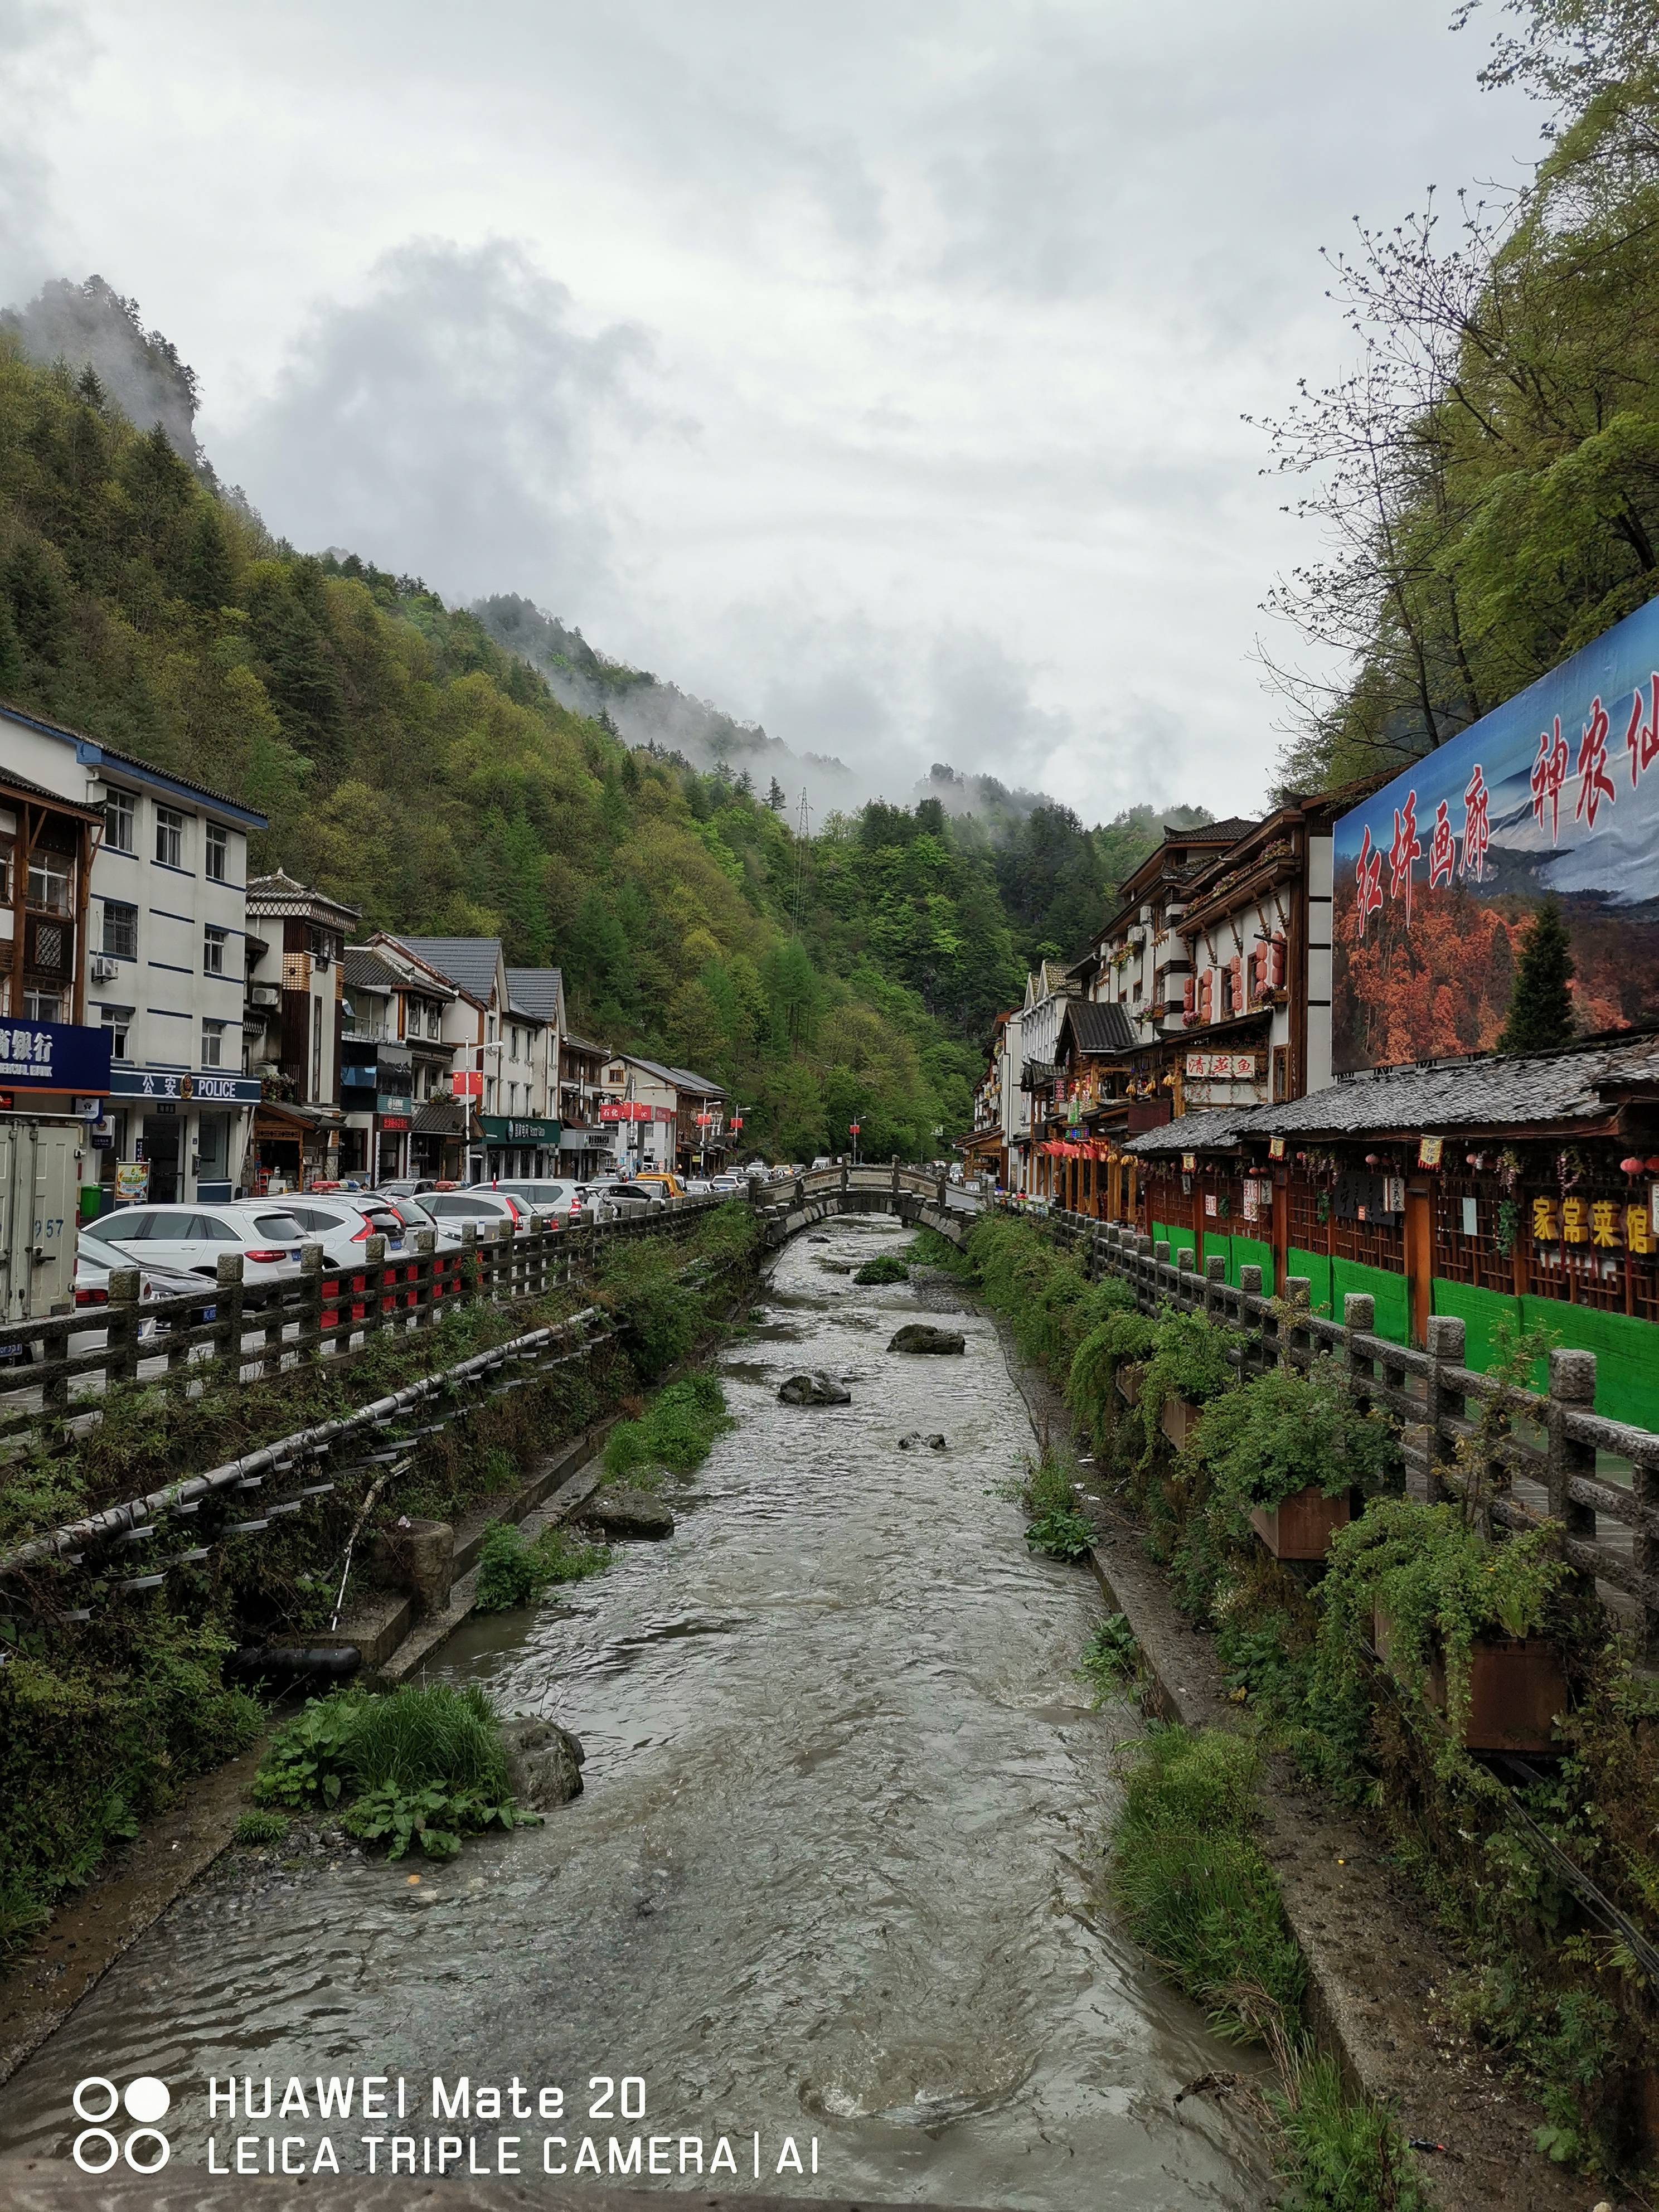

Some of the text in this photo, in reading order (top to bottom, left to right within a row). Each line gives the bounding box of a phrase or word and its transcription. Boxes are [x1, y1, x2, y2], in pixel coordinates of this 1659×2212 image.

[1357, 764, 1489, 938] 红坪画廊
[1188, 1056, 1253, 1075] 清蒸鱼
[142, 1075, 177, 1097] 公安
[198, 1080, 236, 1098] POLICE
[1533, 1196, 1648, 1254] 家常菜馆
